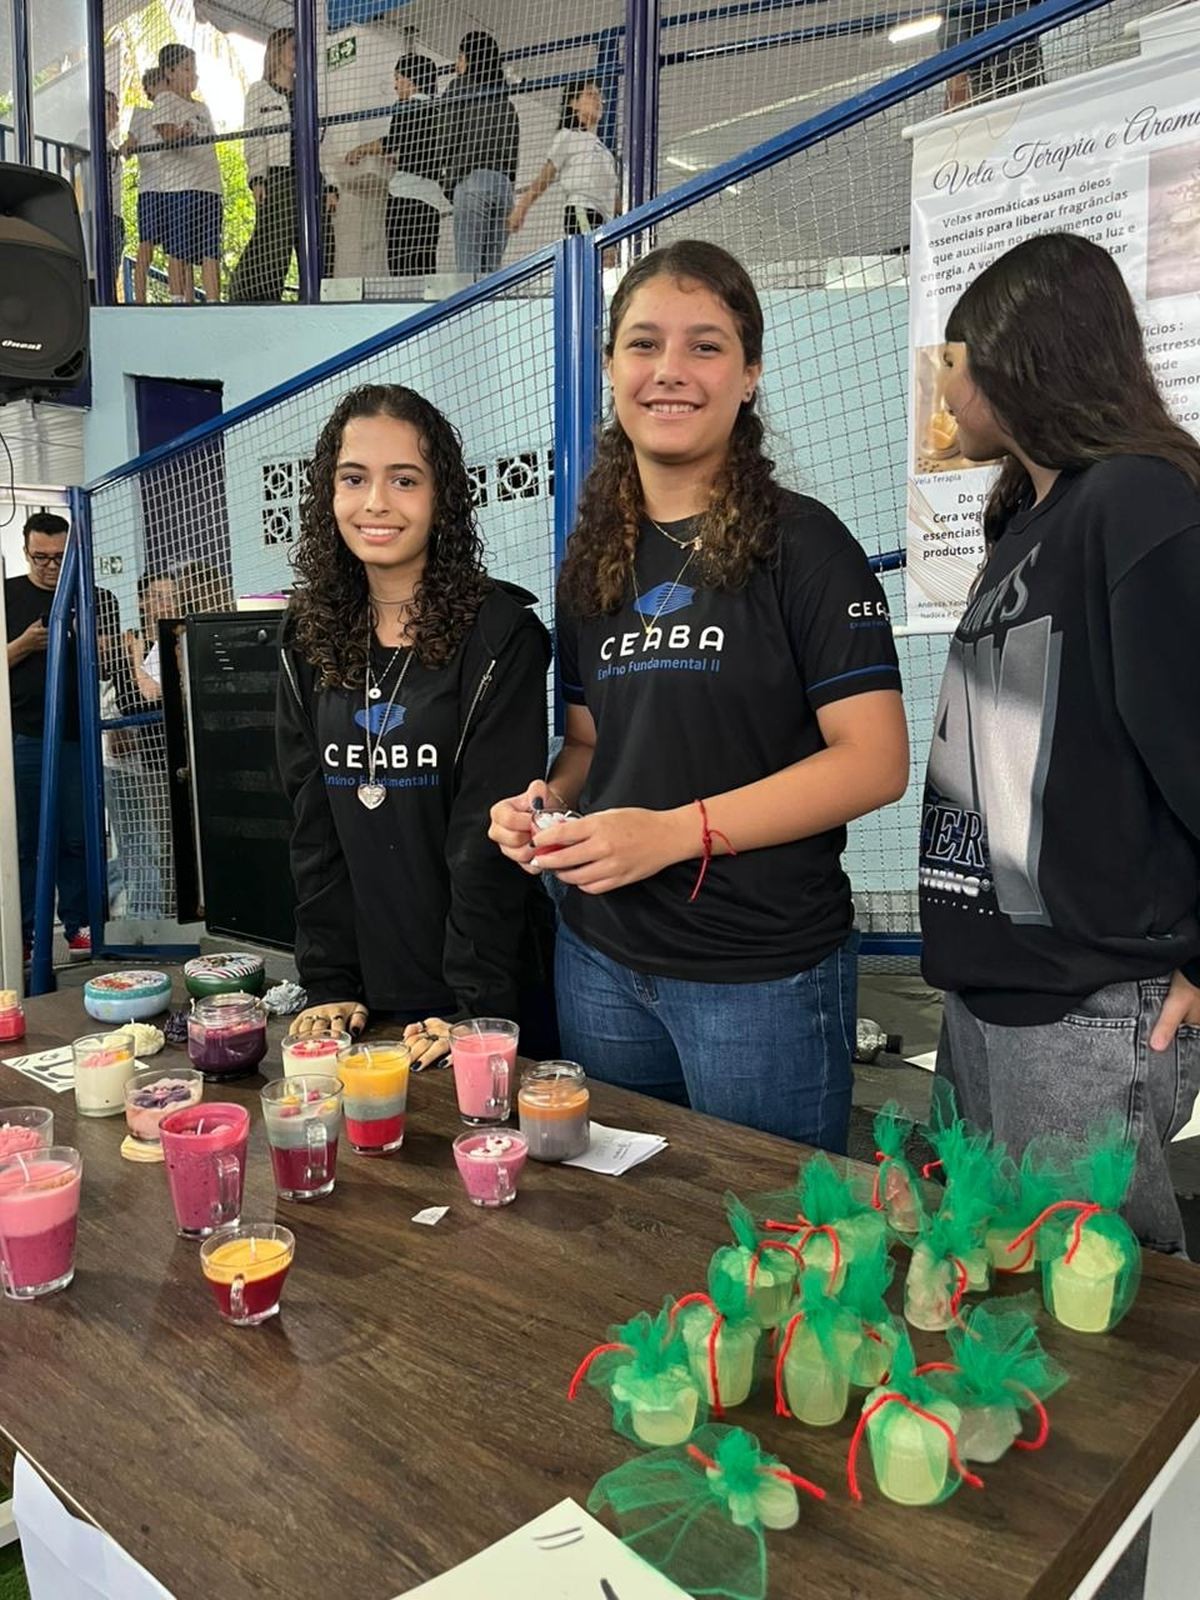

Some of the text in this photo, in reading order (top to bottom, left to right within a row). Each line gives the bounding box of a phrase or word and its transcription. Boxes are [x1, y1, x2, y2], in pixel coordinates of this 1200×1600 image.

[933, 160, 994, 195] Vela
[1002, 138, 1097, 179] Terapia
[1105, 132, 1117, 149] e
[942, 177, 1112, 228] Velas aromáticas usam óleos
[929, 190, 1129, 248] essenciais para liberar fragrâncias
[932, 253, 954, 266] que
[956, 239, 1005, 259] auxiliam
[1008, 234, 1023, 246] no
[1106, 209, 1122, 221] ou
[967, 262, 976, 273] A
[1106, 226, 1124, 240] luz
[1128, 223, 1136, 233] e
[926, 283, 962, 298] aroma
[958, 493, 974, 504] Do
[933, 511, 982, 524] Cera veg
[922, 526, 981, 541] essenciais
[923, 545, 975, 560] produtos
[848, 601, 889, 621] CEA
[600, 624, 725, 661] CEABA
[629, 657, 707, 673] Fundamental
[324, 743, 438, 769] CEABA
